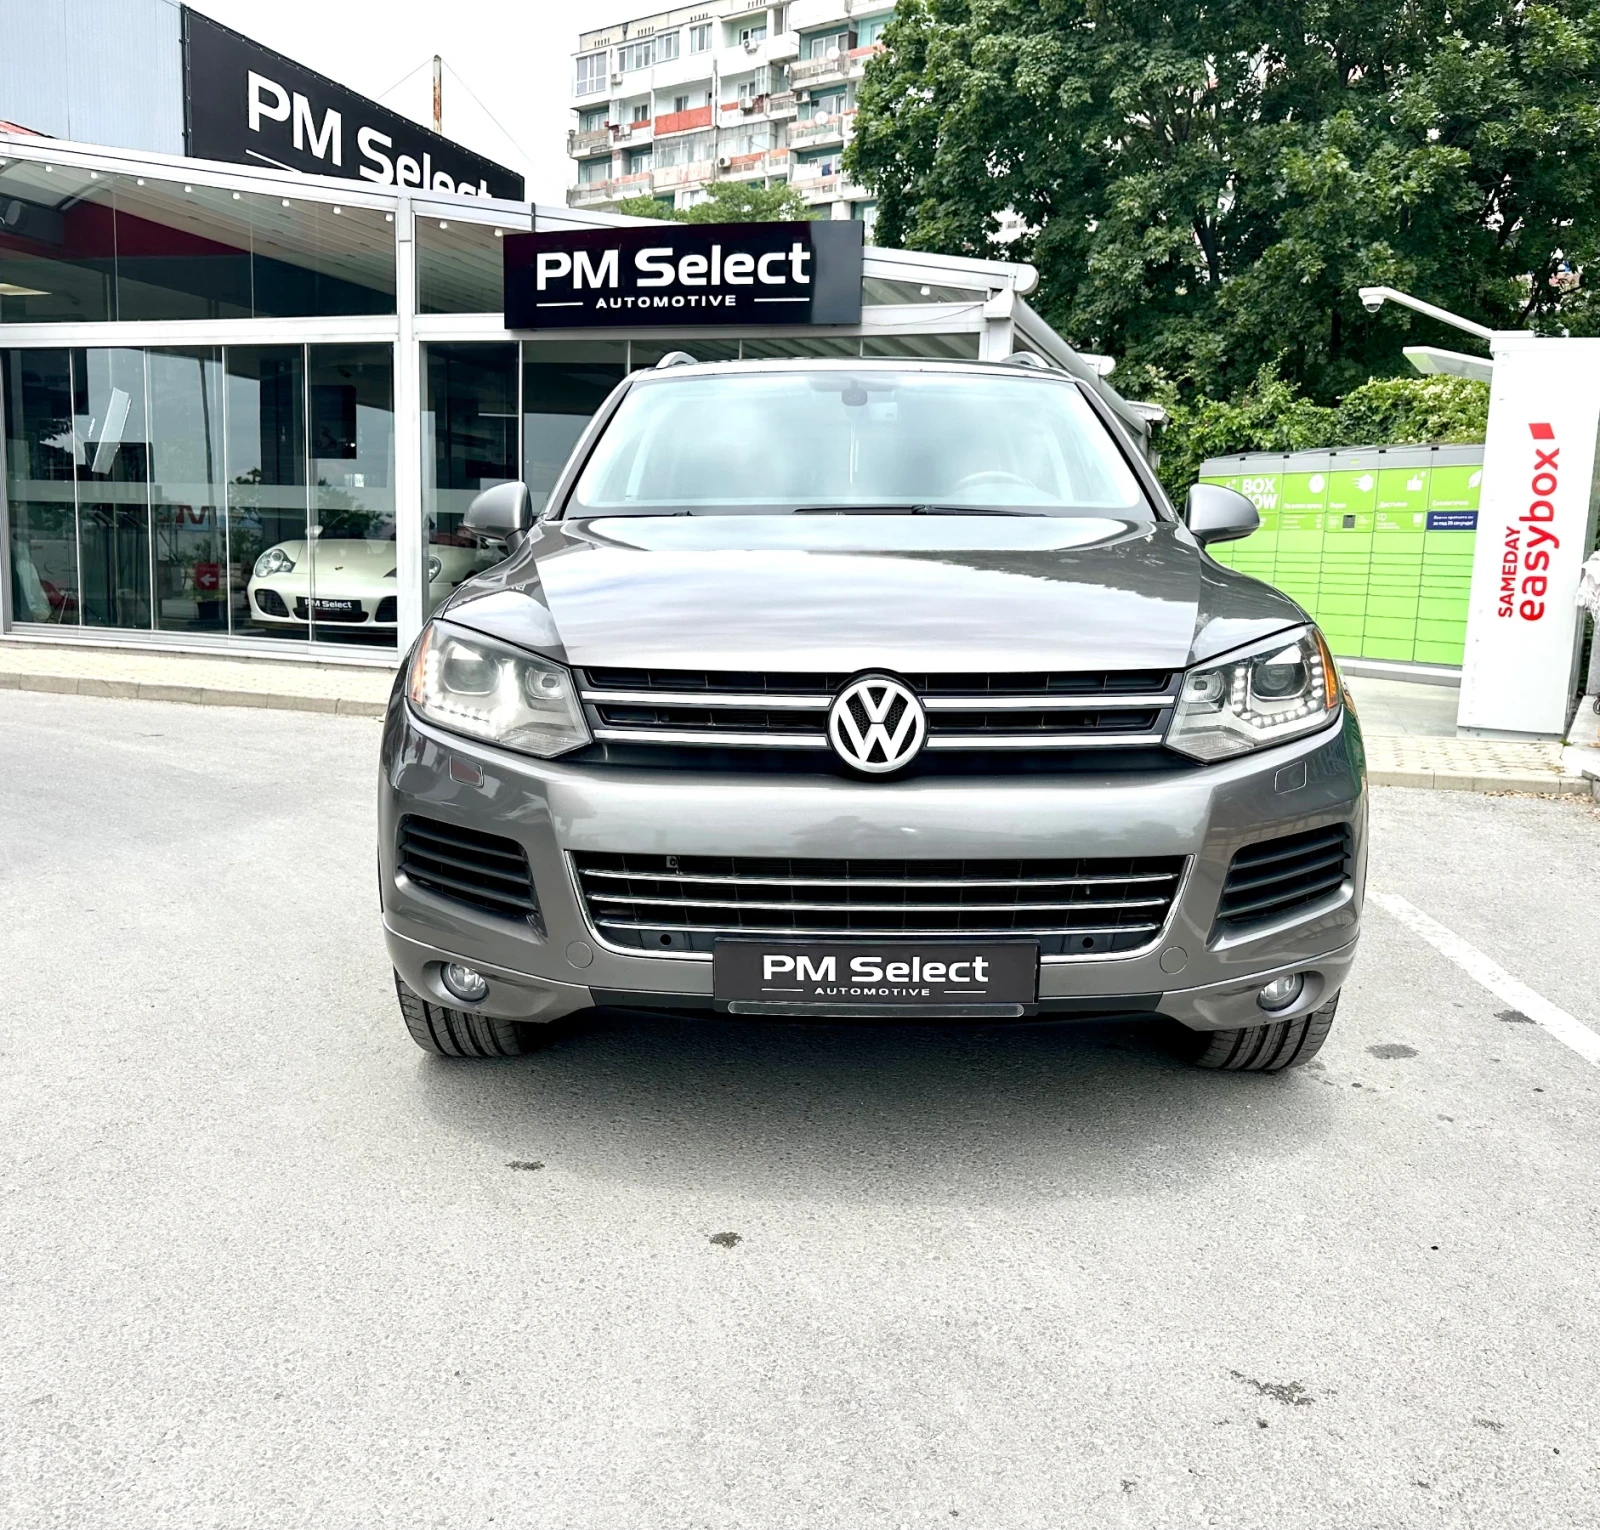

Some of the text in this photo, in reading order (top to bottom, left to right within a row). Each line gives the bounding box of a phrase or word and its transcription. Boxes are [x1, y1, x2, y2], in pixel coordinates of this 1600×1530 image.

[248, 70, 341, 167] PM
[536, 243, 811, 290] PM Select
[596, 295, 736, 309] AUTOMOTIVE
[1242, 478, 1276, 494] BOX
[1519, 448, 1560, 621] easybox
[1498, 526, 1520, 618] SAMEDAY
[829, 679, 925, 773] VW
[763, 955, 989, 982] PM Select
[814, 987, 930, 997] AUTOMOTIVE
